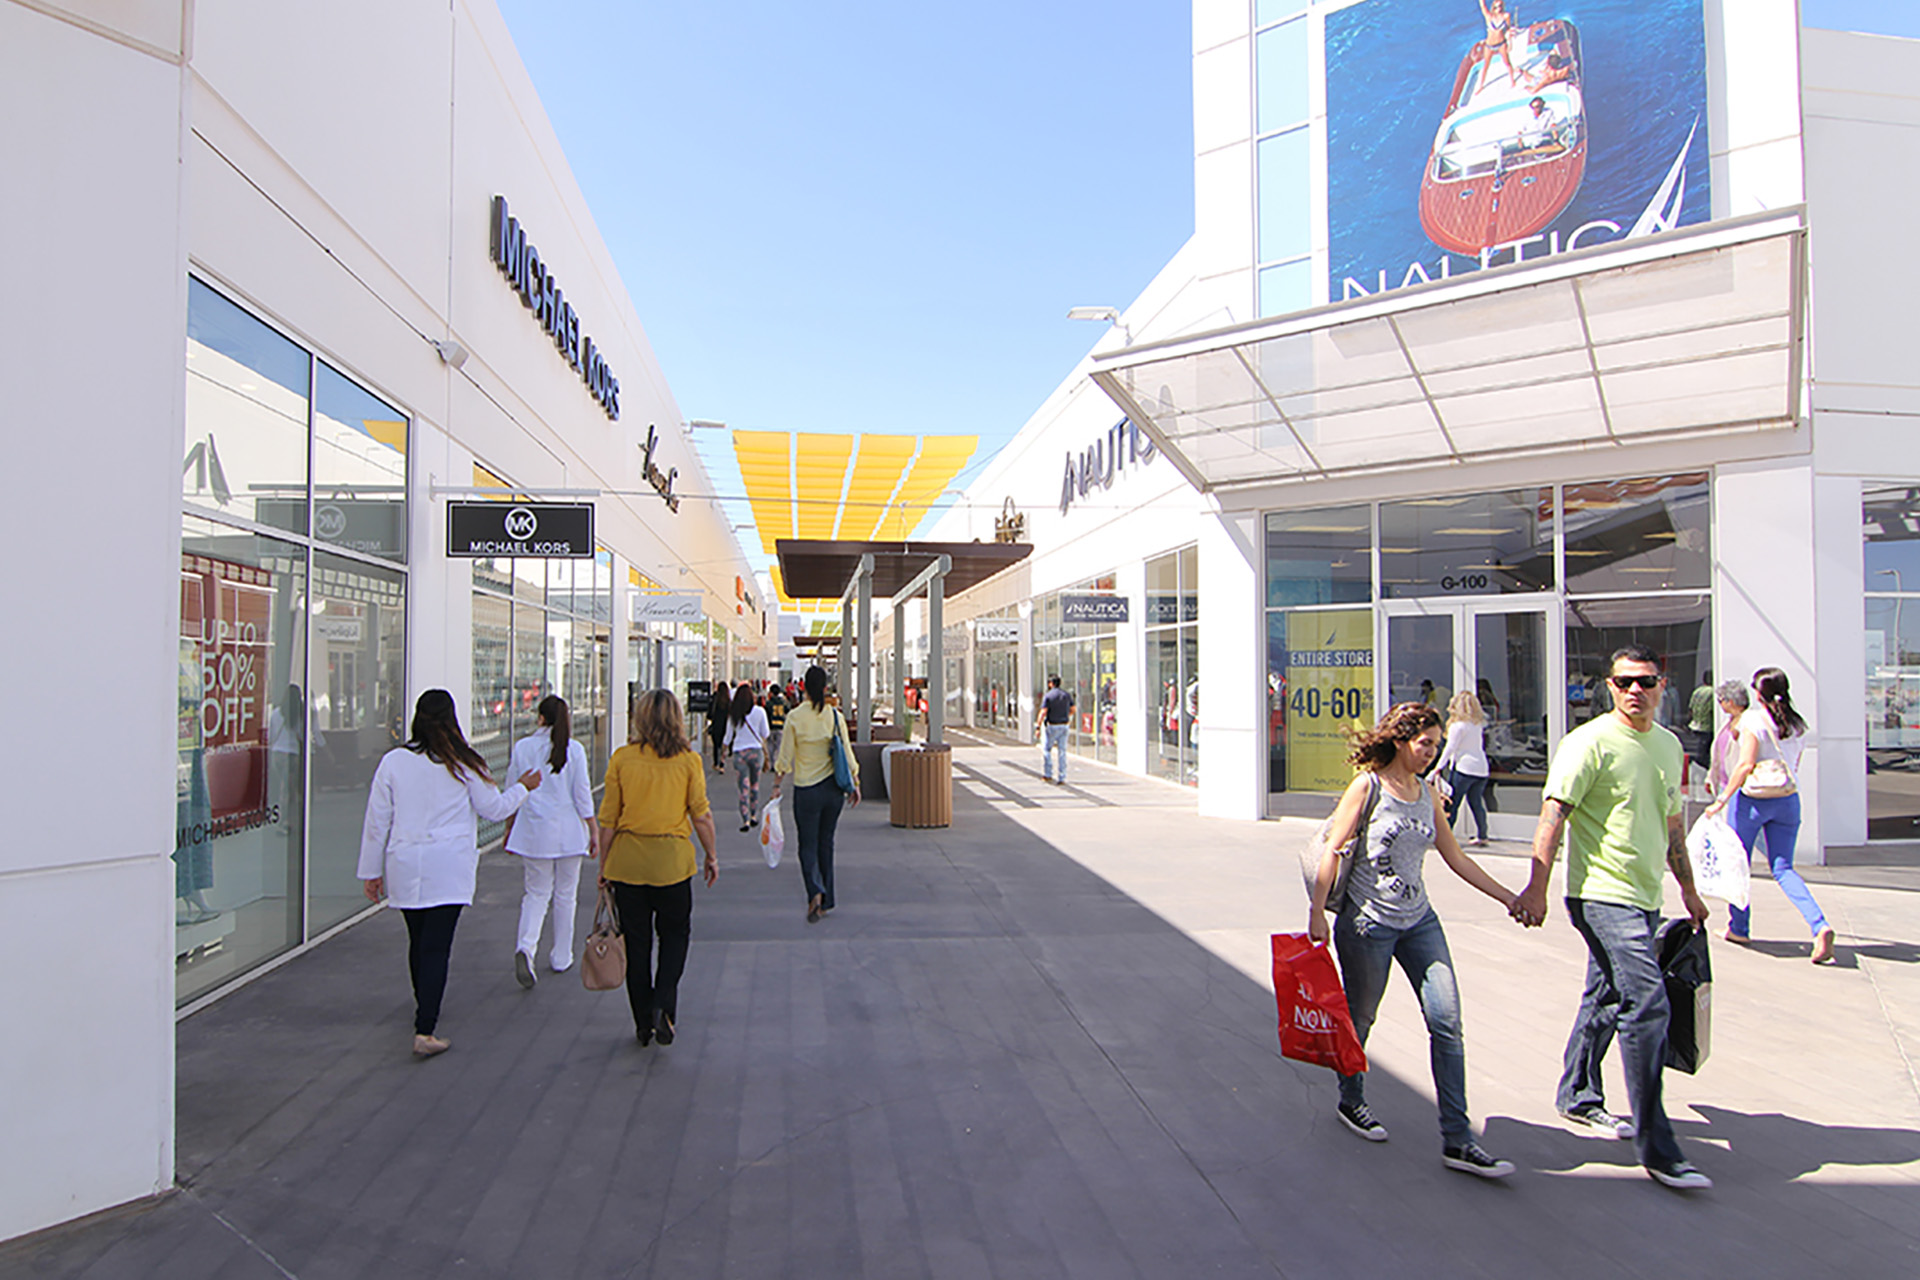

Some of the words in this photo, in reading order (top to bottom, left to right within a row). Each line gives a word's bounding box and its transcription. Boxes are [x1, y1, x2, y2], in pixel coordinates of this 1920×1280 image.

[490, 195, 584, 375] MICHAEL
[581, 336, 620, 422] KORS
[470, 542, 530, 554] MICHAEL
[534, 542, 571, 554] KORS
[1441, 574, 1488, 591] G-100
[1066, 603, 1127, 615] NAUTICA
[202, 618, 229, 646] UP
[234, 621, 257, 647] TO
[202, 651, 256, 692] 50%
[1291, 651, 1332, 666] ENTIRE
[1334, 650, 1372, 666] STORE
[201, 696, 255, 739] OFF
[177, 815, 241, 849] MICHAEL
[245, 804, 280, 831] KORS
